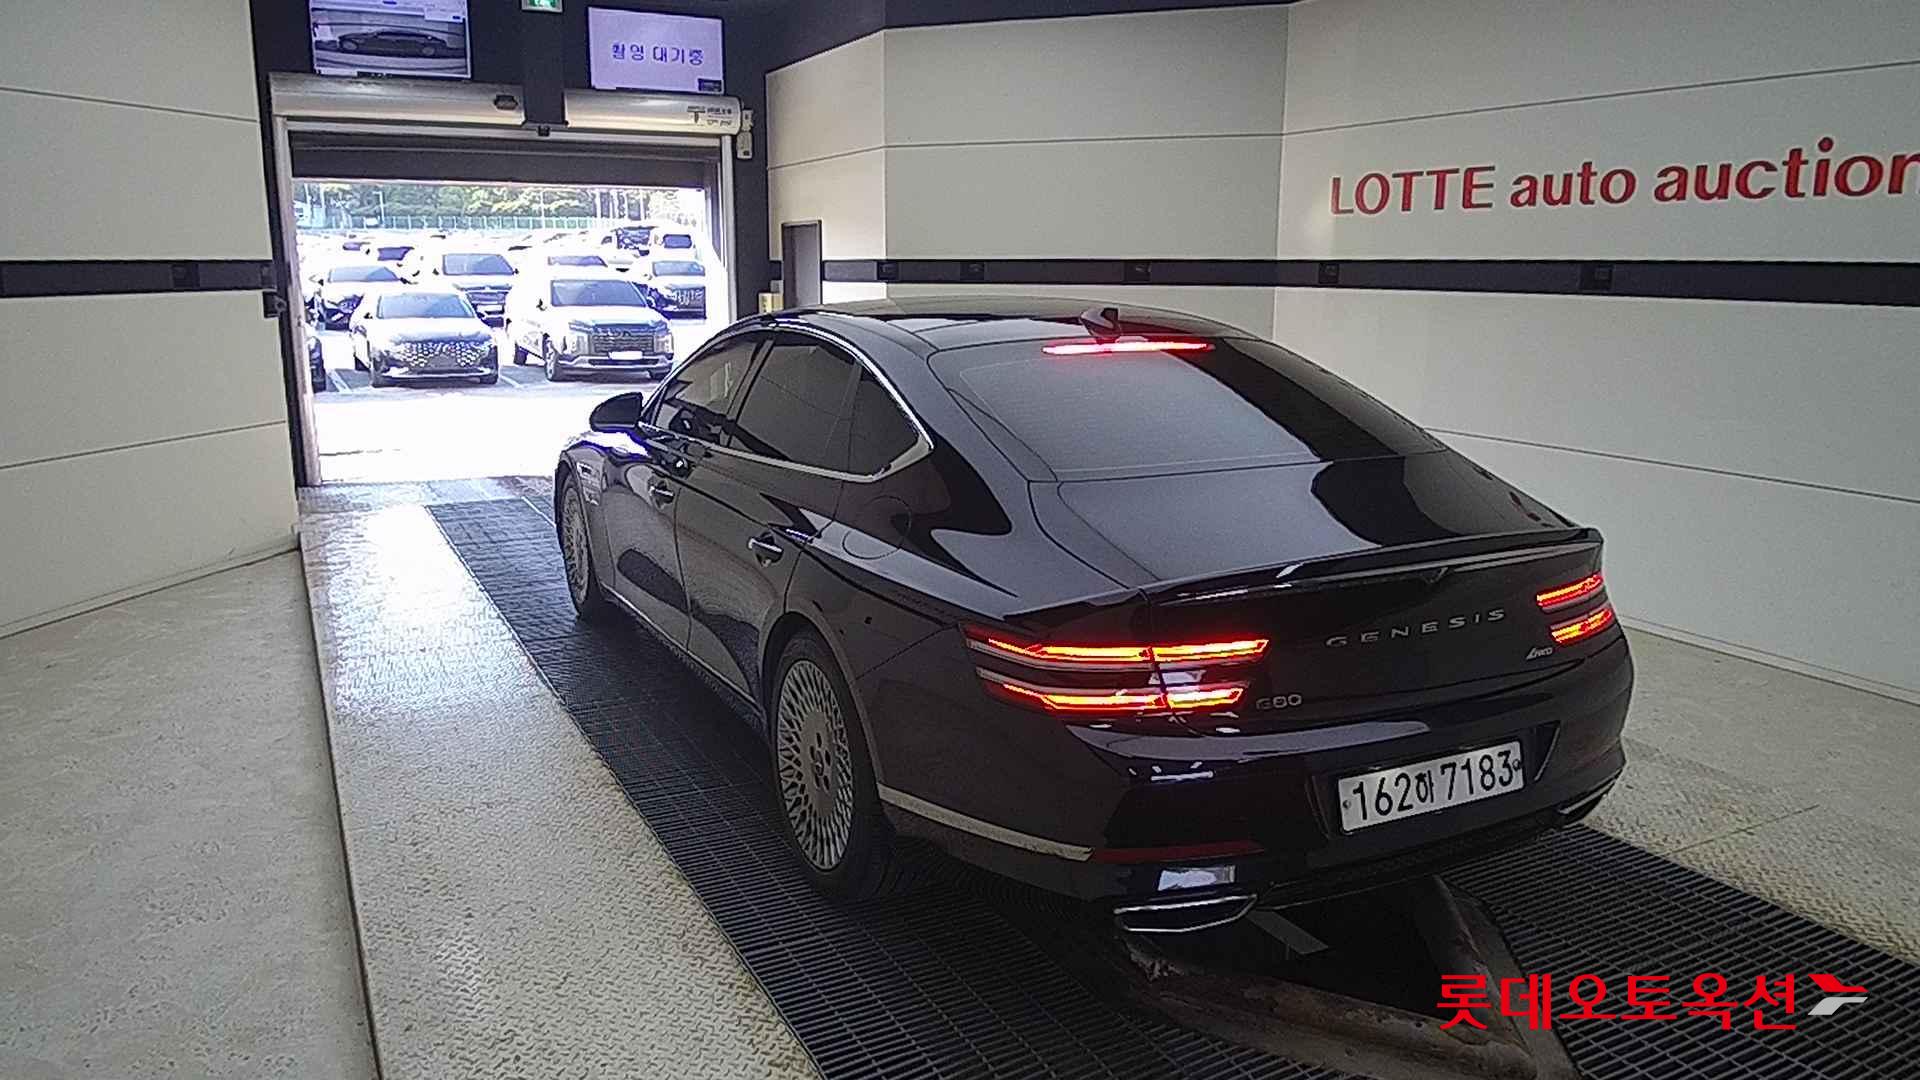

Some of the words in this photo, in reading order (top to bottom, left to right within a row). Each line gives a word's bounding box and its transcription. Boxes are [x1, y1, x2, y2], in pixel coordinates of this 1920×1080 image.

[1330, 165, 1496, 215] LOTTE
[1510, 161, 1637, 208] auto
[1325, 608, 1505, 648] GENESIS
[1256, 694, 1303, 710] G80
